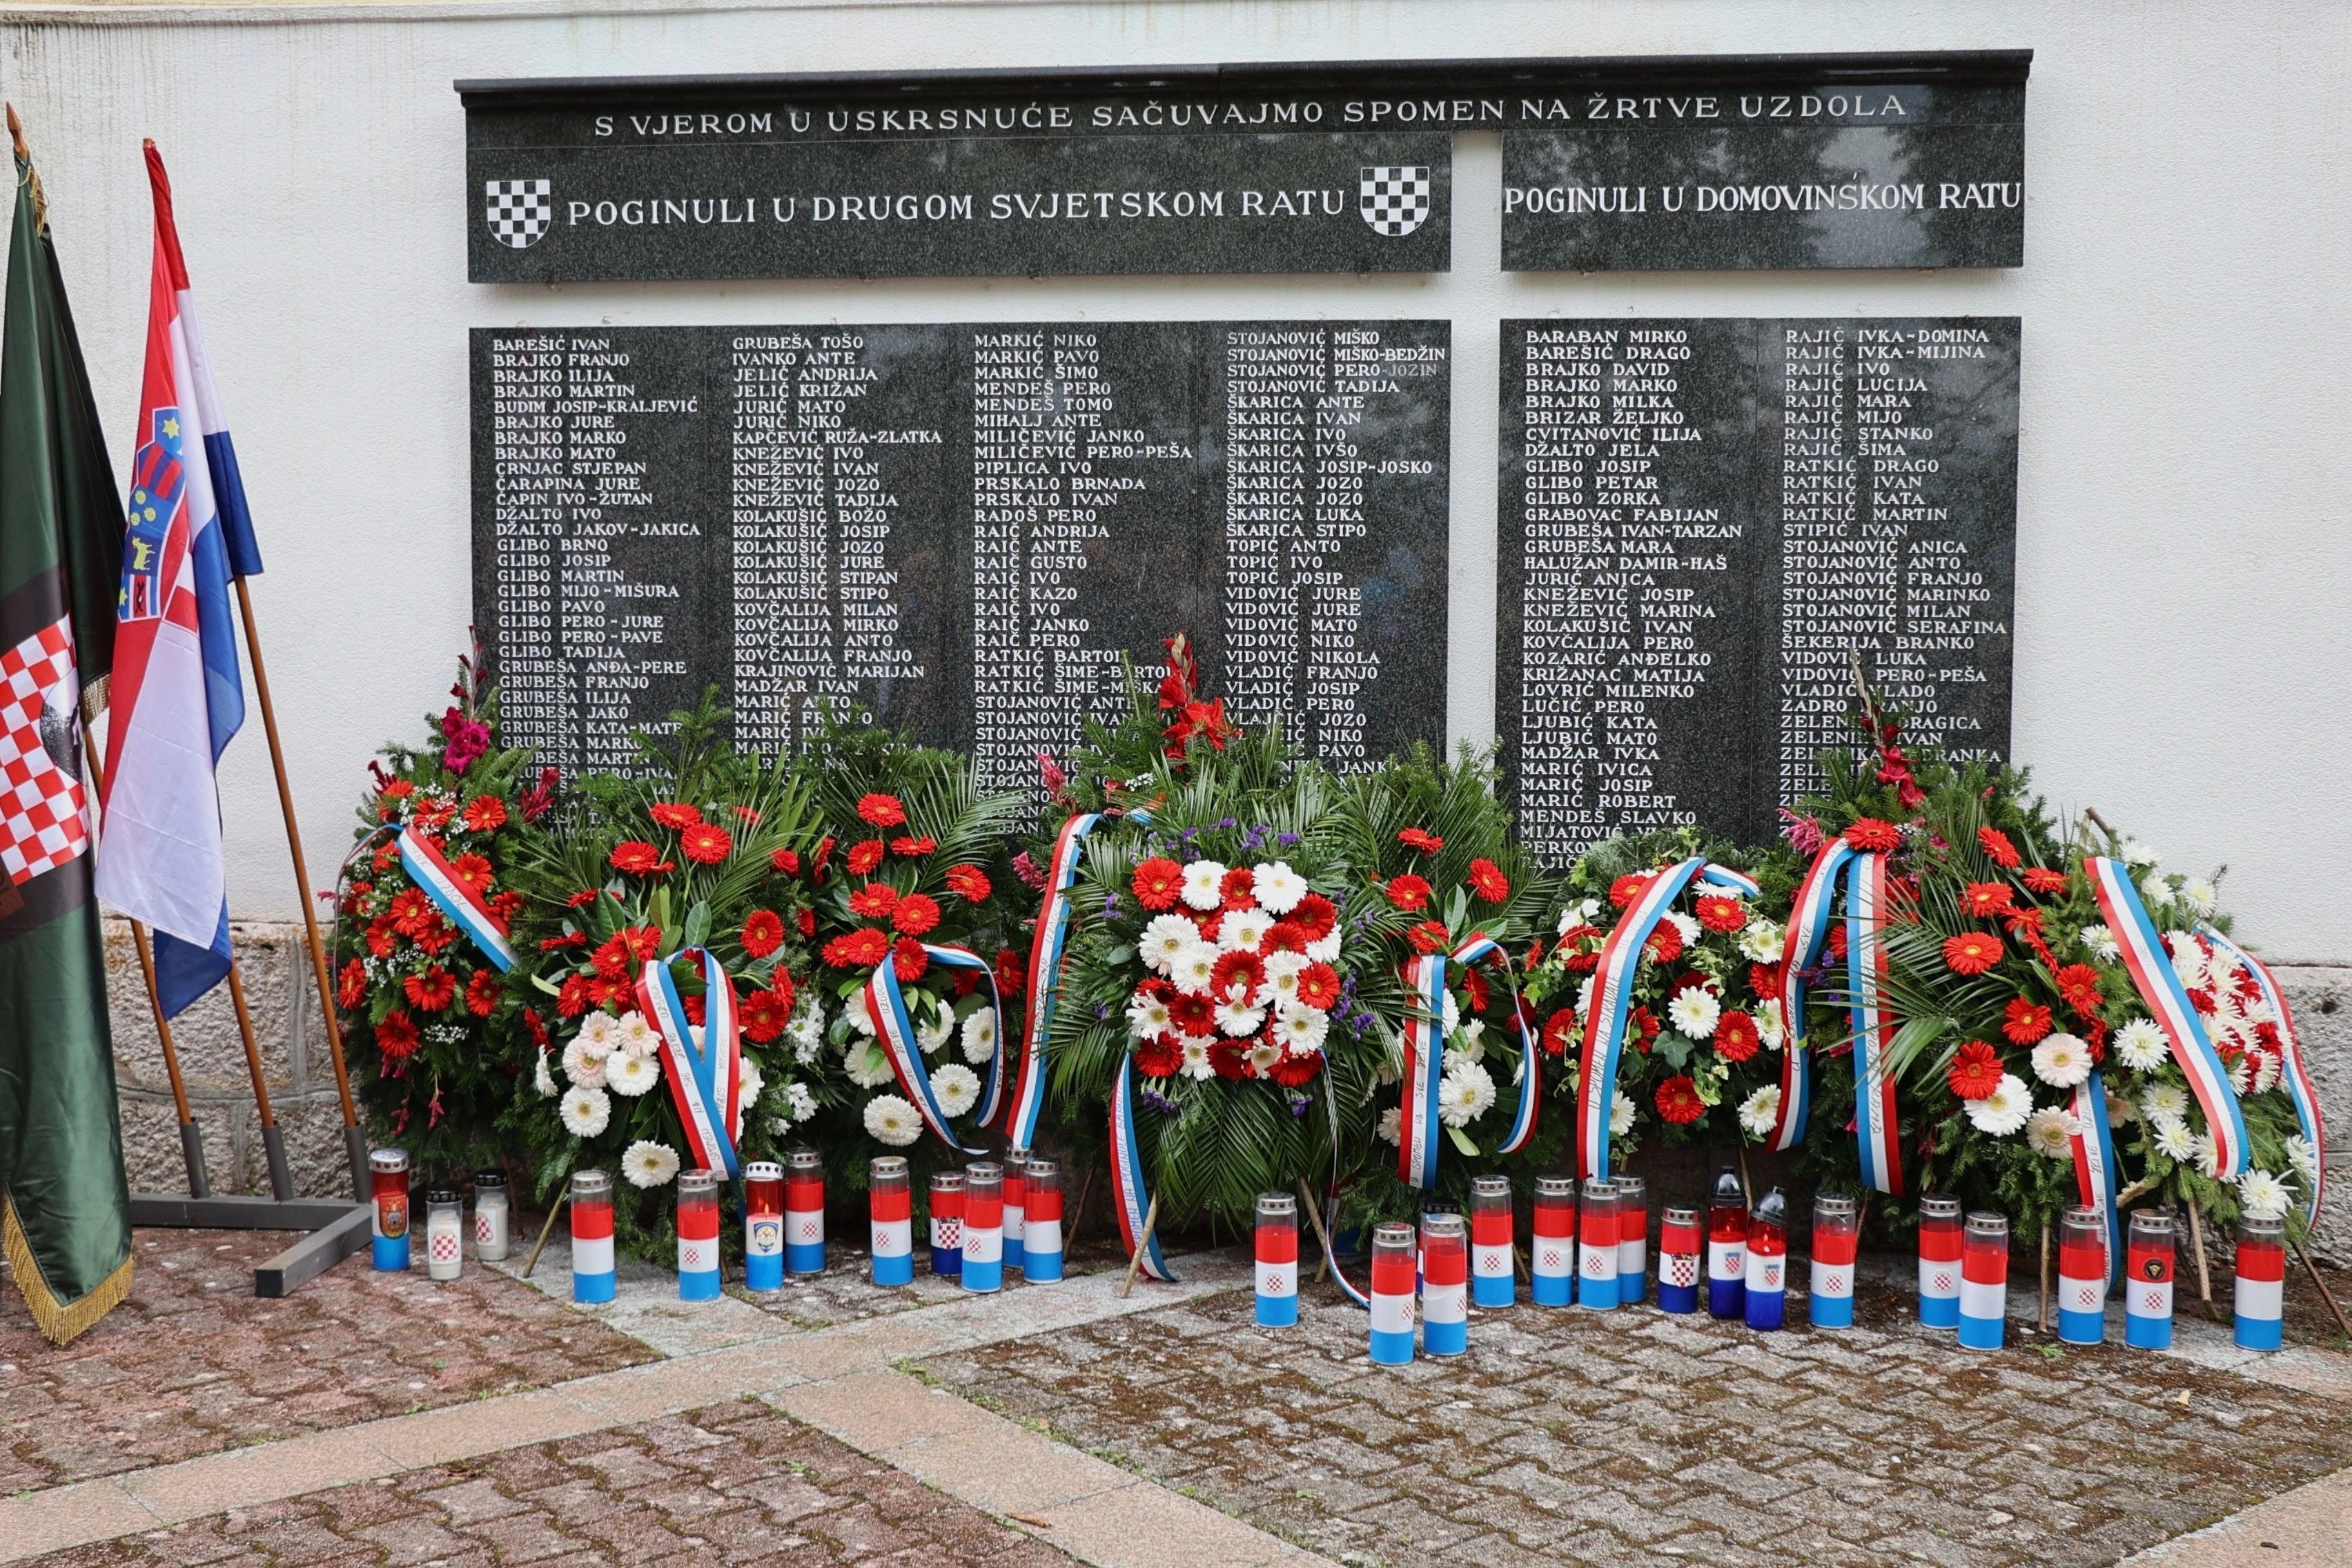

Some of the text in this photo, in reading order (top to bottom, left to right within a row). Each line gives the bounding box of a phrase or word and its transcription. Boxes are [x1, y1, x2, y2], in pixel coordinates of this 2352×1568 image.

[595, 92, 1906, 137] S VJEROM U USKRSNUĆE SAČUVAJMO SPOMEN NA ŽRTVE UZDOLA
[1505, 186, 1647, 213] POGINULI
[1662, 186, 1685, 212] U
[1939, 182, 2021, 209] RATU
[568, 190, 1344, 226] POGINULI U DRUGOM SVJETSKOM RATU
[493, 335, 610, 351] BAREŠIĆ IVAN
[732, 333, 863, 349] GRUBEŠA TOŠO
[1227, 328, 1380, 344] STOJANOVIĆ MIŠKO
[1526, 330, 1687, 343] BARABAN MIRKO
[974, 346, 1099, 364] MARKIĆ PAVO
[1526, 343, 1691, 360] BAREŠIĆ DRAGO
[733, 364, 879, 382] JELIĆ ANDRIJA
[1785, 360, 1890, 375] RAJIČ IVO
[493, 384, 635, 398] BRAJKO MARTIN
[1227, 377, 1401, 393] STOJANOVIĆ TADIJA
[493, 401, 546, 413] BUDIM
[974, 395, 1113, 411] MENDEŠ TOMO
[734, 412, 841, 429] JURIĆ NIKO
[974, 413, 1101, 427] MIHALJ ANTE
[1227, 409, 1361, 425] ŠKARICA IVAN
[1525, 408, 1684, 424] BRIZAR ŽELJKO
[732, 427, 818, 444] KAPČEVIĆ
[974, 427, 1144, 443] MILIČEVIĆ JANKO
[1526, 424, 1702, 442] CVITANOVIĆ ILIJA
[1784, 424, 1933, 440] RAJIČ STANKO
[495, 462, 647, 475] CRNJAC STJEPAN
[974, 461, 1092, 474] PIPLICA IVO
[1226, 457, 1305, 473] ŠKARICA
[1783, 456, 1939, 473] RATKIĆ DRAGO
[496, 474, 641, 491] ČARAPINA JURE
[974, 477, 1146, 490] PRSKALO BRNADA
[733, 490, 899, 507] KNEŽEVIĆ TADIJA
[496, 504, 602, 520] DŽALTO IVO
[974, 506, 1097, 522] RADOŠ PERO
[1226, 504, 1364, 521] ŠKARICA LUKA
[1525, 508, 1719, 522] GRABOVAC FABIJAN
[733, 522, 890, 538] KOLAKUŠIĆ JOSIP
[1525, 520, 1614, 537] GRUBEŠA
[1783, 520, 1908, 537] STIPIĆ IVAN
[497, 554, 611, 567] GLIBO JOSIP
[974, 552, 1088, 569] RAIČ GUSTO
[1226, 552, 1323, 569] TOPIĆ IVO
[1783, 568, 1983, 585] STOJANOVIĆ FRANJO
[734, 600, 898, 616] KOVČALIJA MILAN
[1781, 632, 1974, 649] ŠEKERIJA BRANKO
[1225, 647, 1380, 664] VIDOVIĆ NIKOLA
[1522, 648, 1712, 666] KOZARIĆ ANĐELKO
[734, 661, 925, 678] KRAJINOVIĆ MARIJAN
[499, 672, 649, 689] GRUBEŠA FRANJO
[734, 676, 859, 693] MADŽAR IVAN
[1225, 678, 1360, 695] VLADIĆ JOSIP
[1522, 680, 1694, 698] LOVRIĆ MILENKO
[1520, 790, 1676, 808] MARIĆ ROBERT
[1589, 1050, 1607, 1096] SPOMEN
